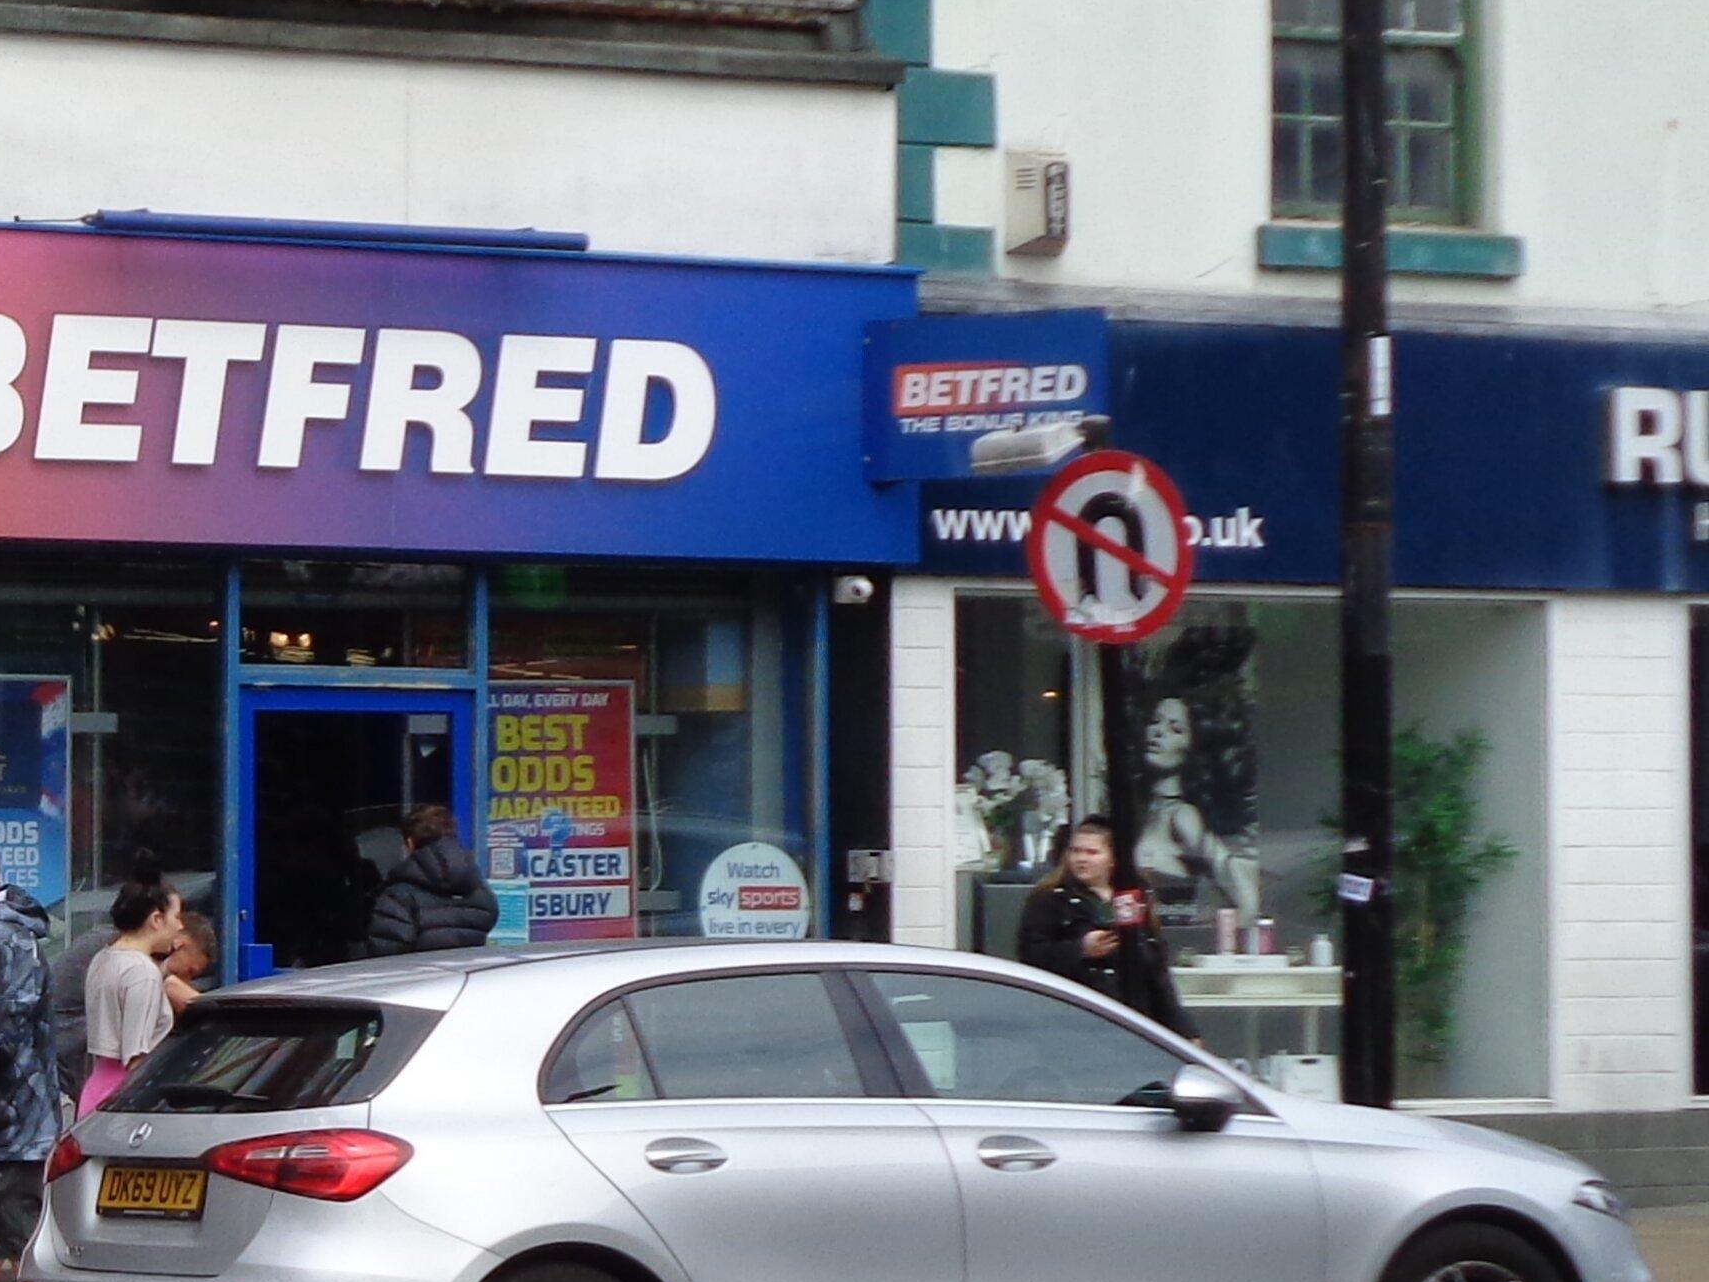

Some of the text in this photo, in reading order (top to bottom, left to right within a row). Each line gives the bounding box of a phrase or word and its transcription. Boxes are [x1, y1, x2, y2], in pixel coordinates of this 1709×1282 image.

[900, 364, 1088, 408] BETFRED
[900, 416, 941, 434] THE
[944, 412, 1026, 433] BONUS
[534, 693, 579, 707] EVERY
[582, 692, 610, 707] DAY
[496, 713, 590, 752] BEST
[491, 755, 596, 793] ODDS
[727, 861, 780, 878] Watch
[707, 886, 799, 909] sky sports
[709, 916, 801, 938] live in every
[108, 1169, 198, 1205] DK69 UYZ
